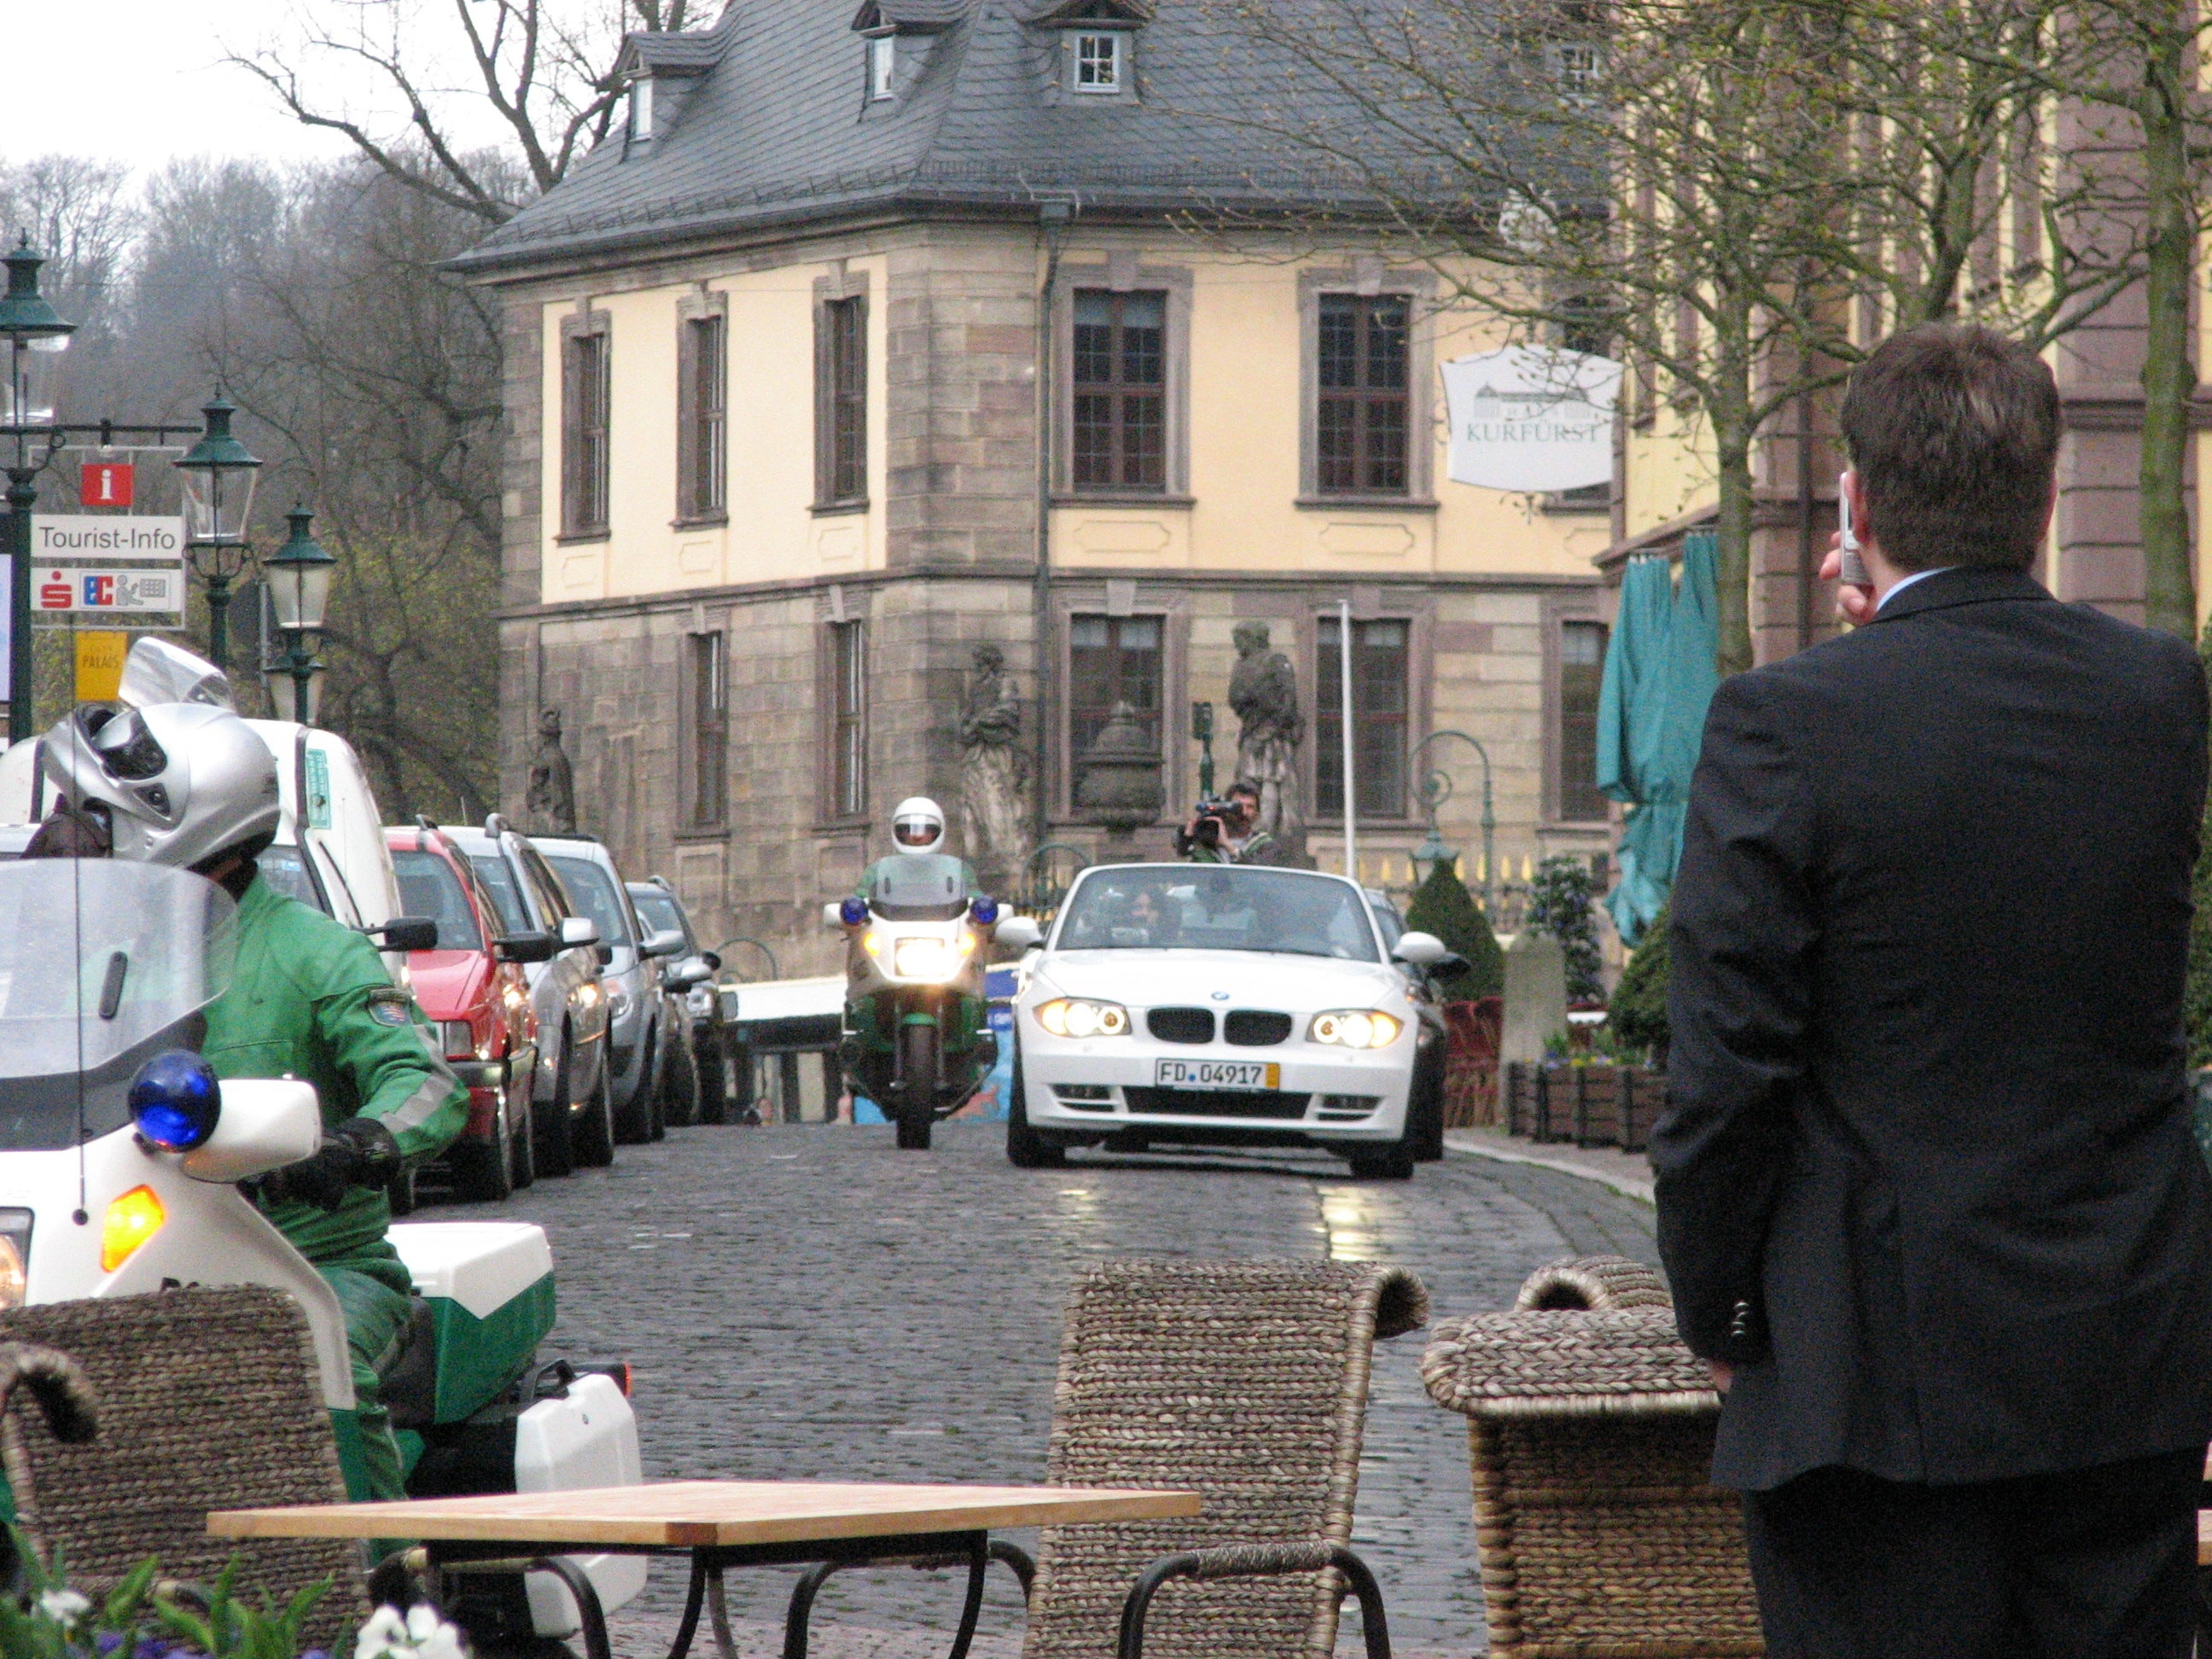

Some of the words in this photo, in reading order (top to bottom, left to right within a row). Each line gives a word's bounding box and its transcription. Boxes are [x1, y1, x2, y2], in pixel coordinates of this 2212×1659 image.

[100, 469, 113, 500] i
[39, 527, 176, 550] Tourist-Info
[1159, 1062, 1187, 1082] FD
[1199, 1063, 1262, 1084] 04917
